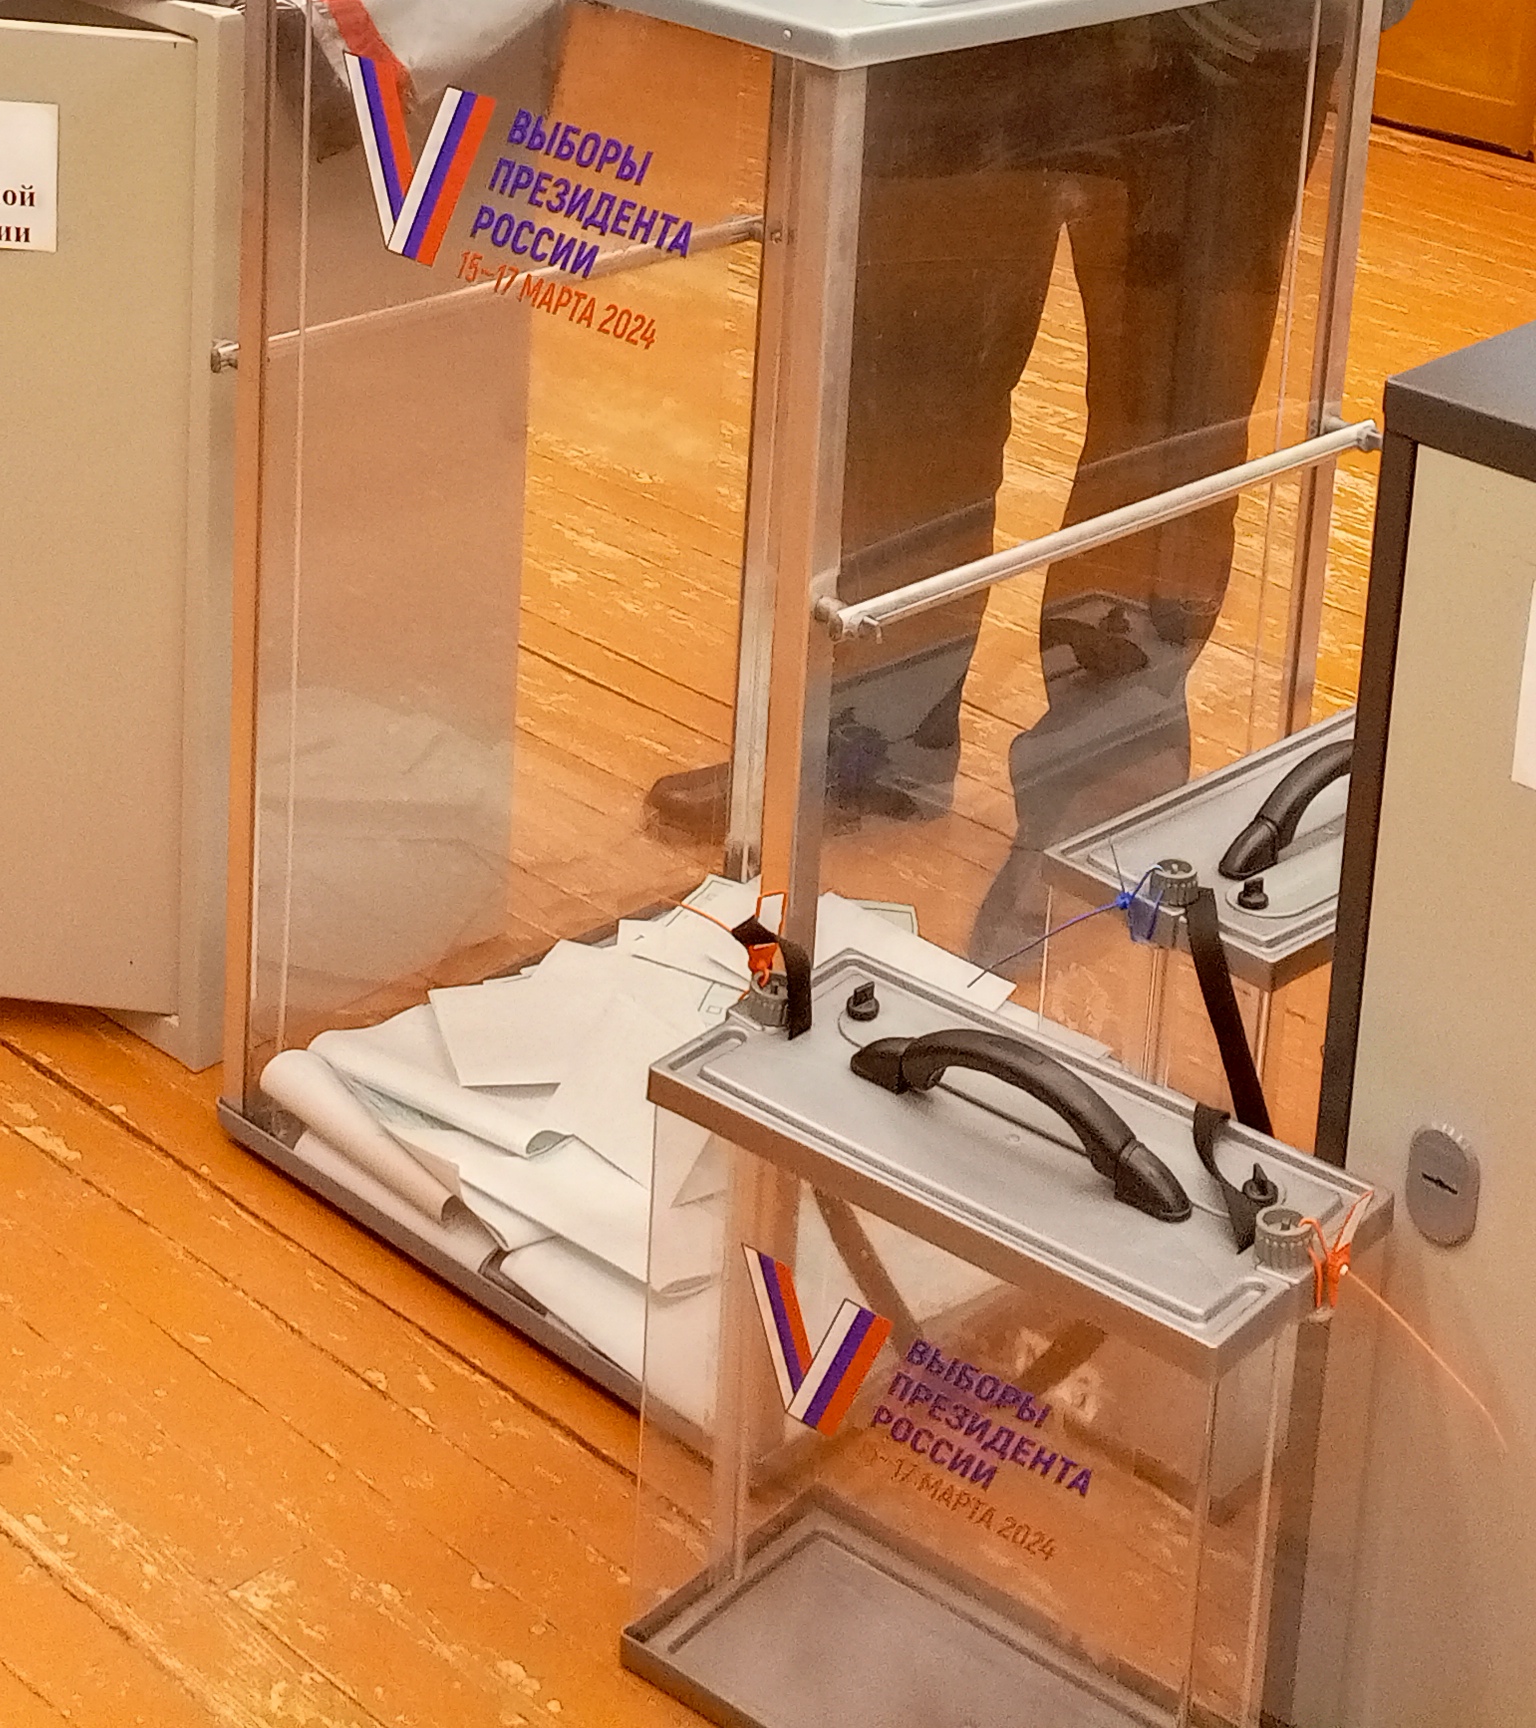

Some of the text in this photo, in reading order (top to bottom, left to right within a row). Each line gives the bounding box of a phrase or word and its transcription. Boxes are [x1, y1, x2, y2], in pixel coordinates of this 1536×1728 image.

[506, 107, 655, 187] ВЫБОРЫ
[469, 204, 601, 280] РОССИИ
[487, 156, 695, 260] ПРЕЗИДЕНТА
[517, 273, 597, 329] МАРТА
[596, 304, 659, 351] 2024
[905, 1337, 1054, 1430] ВЫБОРЫ
[869, 1403, 999, 1493] РОССИИ
[887, 1370, 1095, 1499] ПРЕЗИДЕНТА
[915, 1471, 999, 1532] МАРТА
[996, 1514, 1058, 1562] 2024
